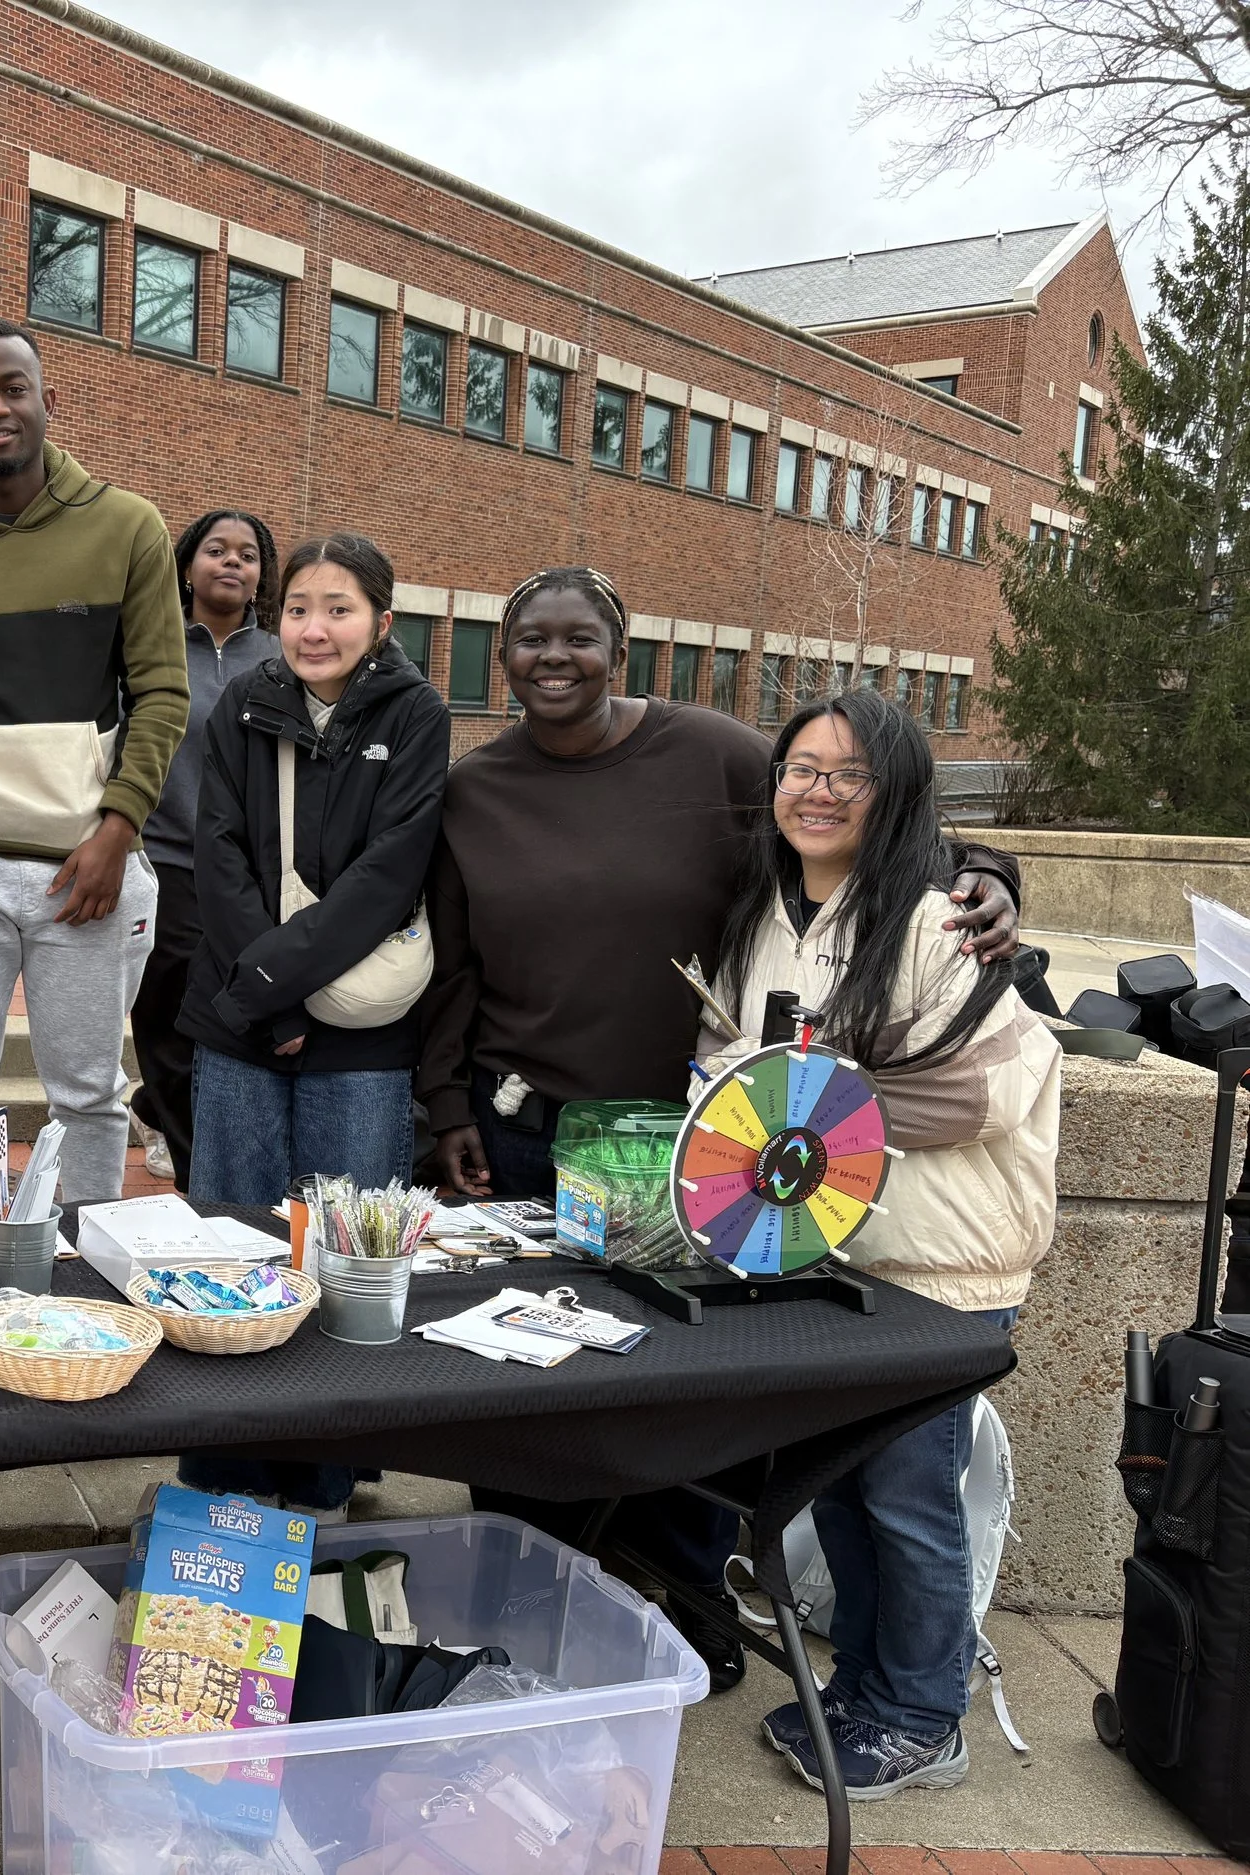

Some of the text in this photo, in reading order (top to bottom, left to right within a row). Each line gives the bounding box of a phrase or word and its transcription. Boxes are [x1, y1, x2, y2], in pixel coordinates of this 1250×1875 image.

[729, 1105, 745, 1127] PUNCH
[812, 1138, 827, 1164] SPIN
[568, 1183, 592, 1204] PUNCH
[797, 1181, 819, 1202] WIN
[814, 1188, 847, 1225] SOUR PUNCH
[790, 1205, 801, 1243] SQUISHY
[759, 1207, 777, 1265] RICE KRISPIES
[519, 1312, 544, 1321] BIG
[208, 1503, 263, 1523] RICE KRISPIES
[209, 1513, 261, 1537] TREATS
[286, 1519, 308, 1536] 60
[285, 1533, 305, 1544] BARS
[170, 1549, 197, 1563] RICE
[196, 1552, 246, 1577] KRISPIES
[273, 1560, 302, 1585] 60
[171, 1561, 242, 1593] TREATS
[272, 1580, 298, 1594] BARS
[39, 1600, 65, 1627] Pickup
[64, 1593, 84, 1616] FREE
[47, 1610, 69, 1633] Same
[260, 1656, 289, 1669] Rainbow
[270, 1646, 283, 1659] 20
[247, 1705, 287, 1722] Chocolatey
[261, 1697, 275, 1708] 20
